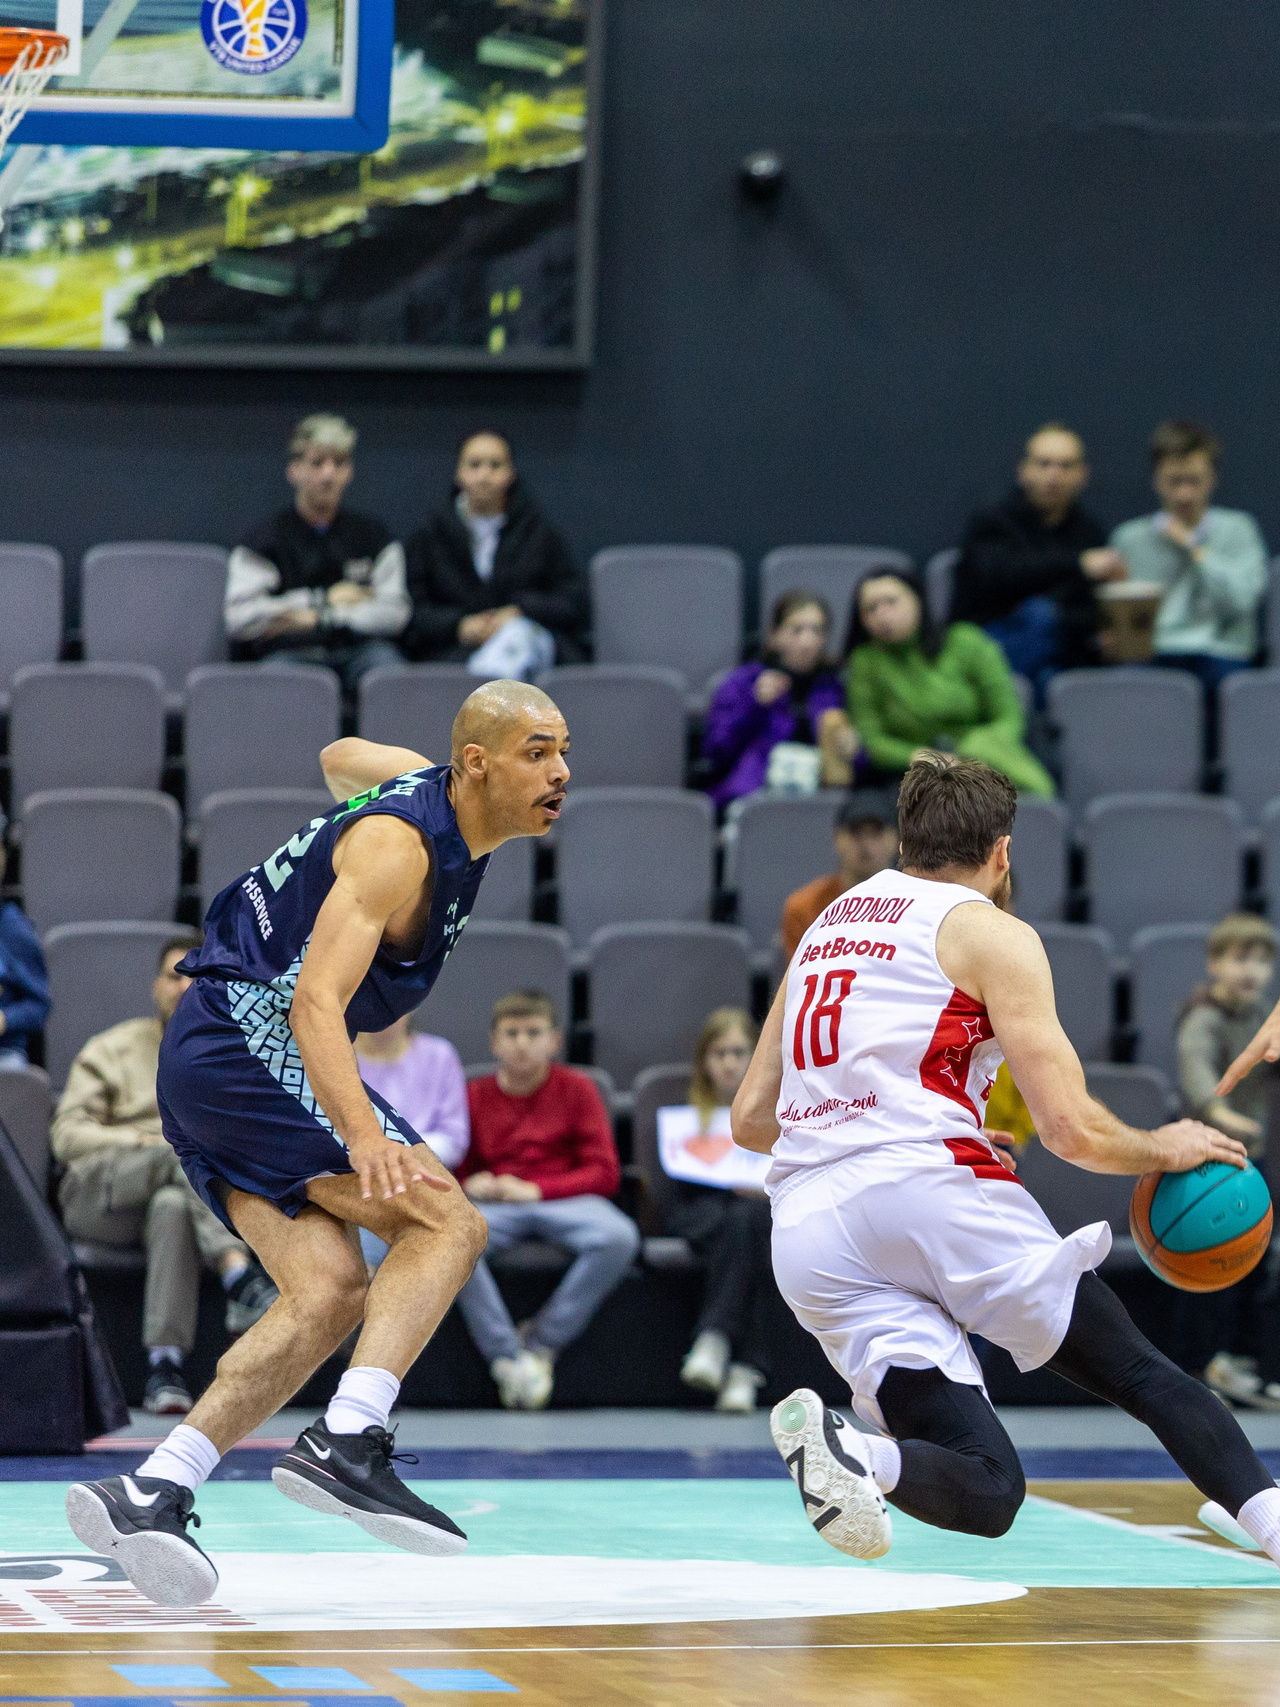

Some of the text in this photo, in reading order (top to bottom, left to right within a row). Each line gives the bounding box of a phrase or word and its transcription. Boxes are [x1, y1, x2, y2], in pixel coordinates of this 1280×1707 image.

[820, 897, 915, 928] VORONOV
[799, 937, 897, 967] BetBoom
[793, 969, 857, 1071] 18
